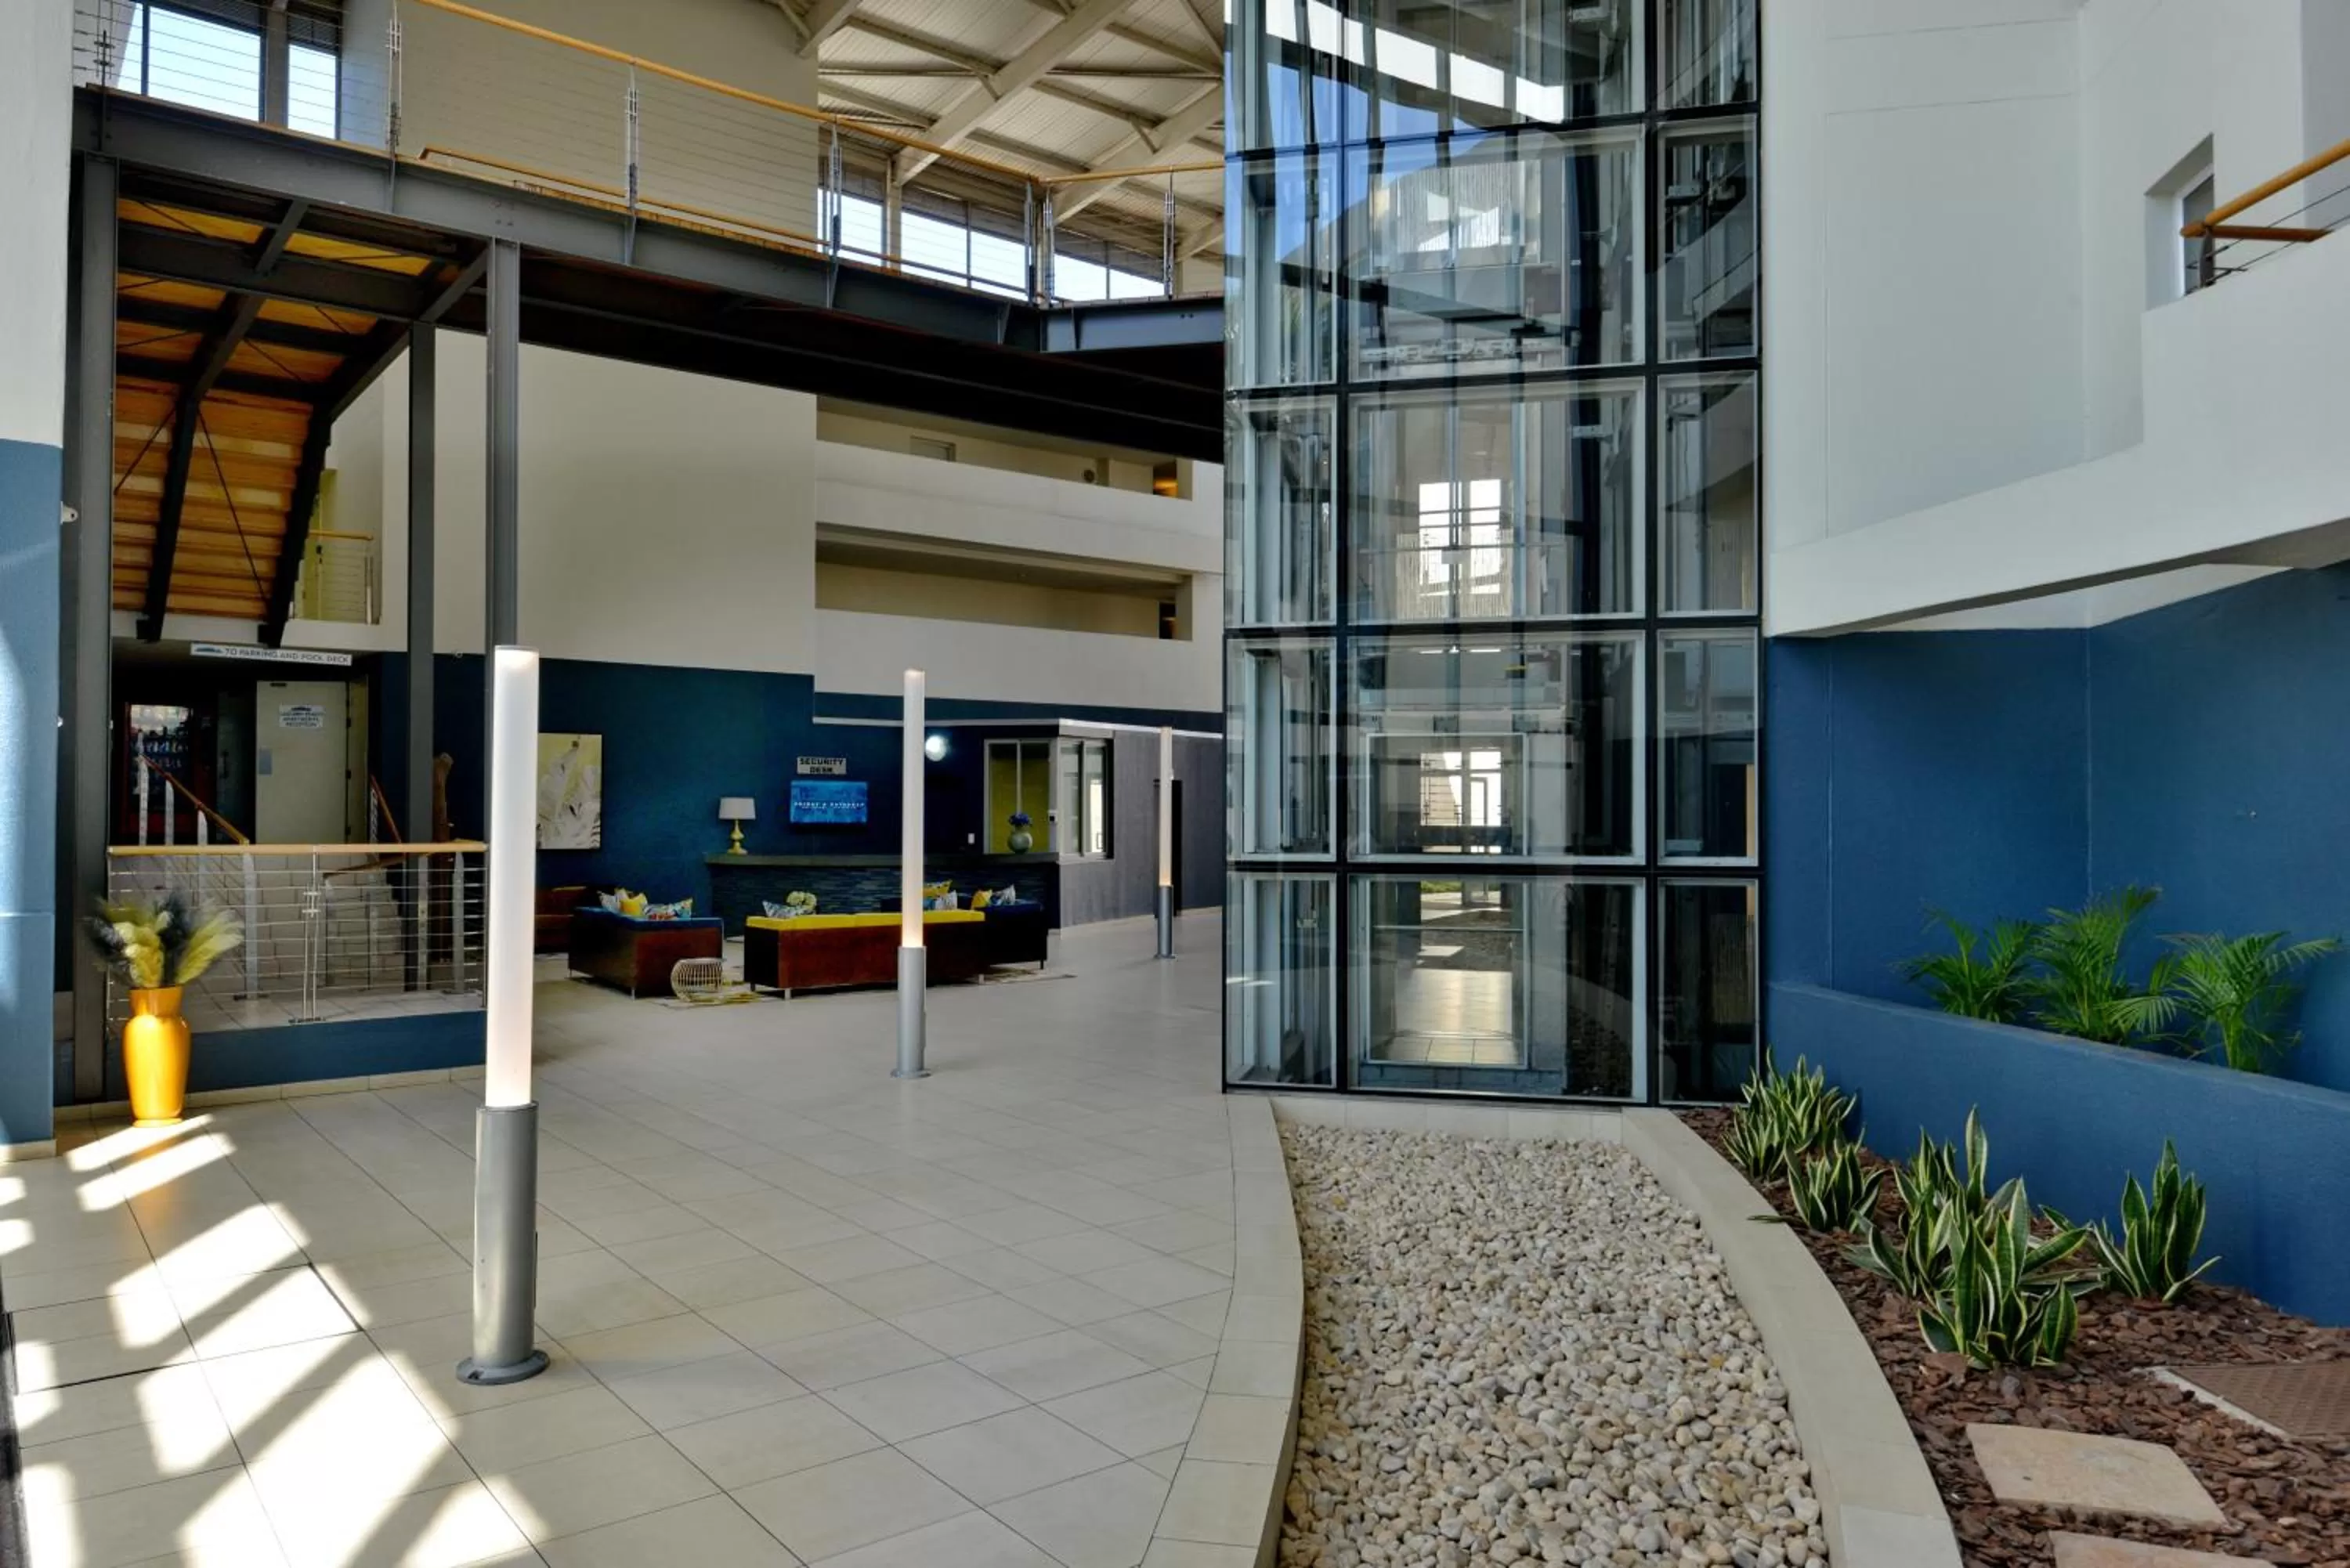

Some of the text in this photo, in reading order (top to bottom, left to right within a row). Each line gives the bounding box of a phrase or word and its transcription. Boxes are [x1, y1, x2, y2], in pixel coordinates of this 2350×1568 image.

[239, 649, 277, 659] PARKING
[279, 652, 298, 660] AND
[327, 655, 349, 663] DECK
